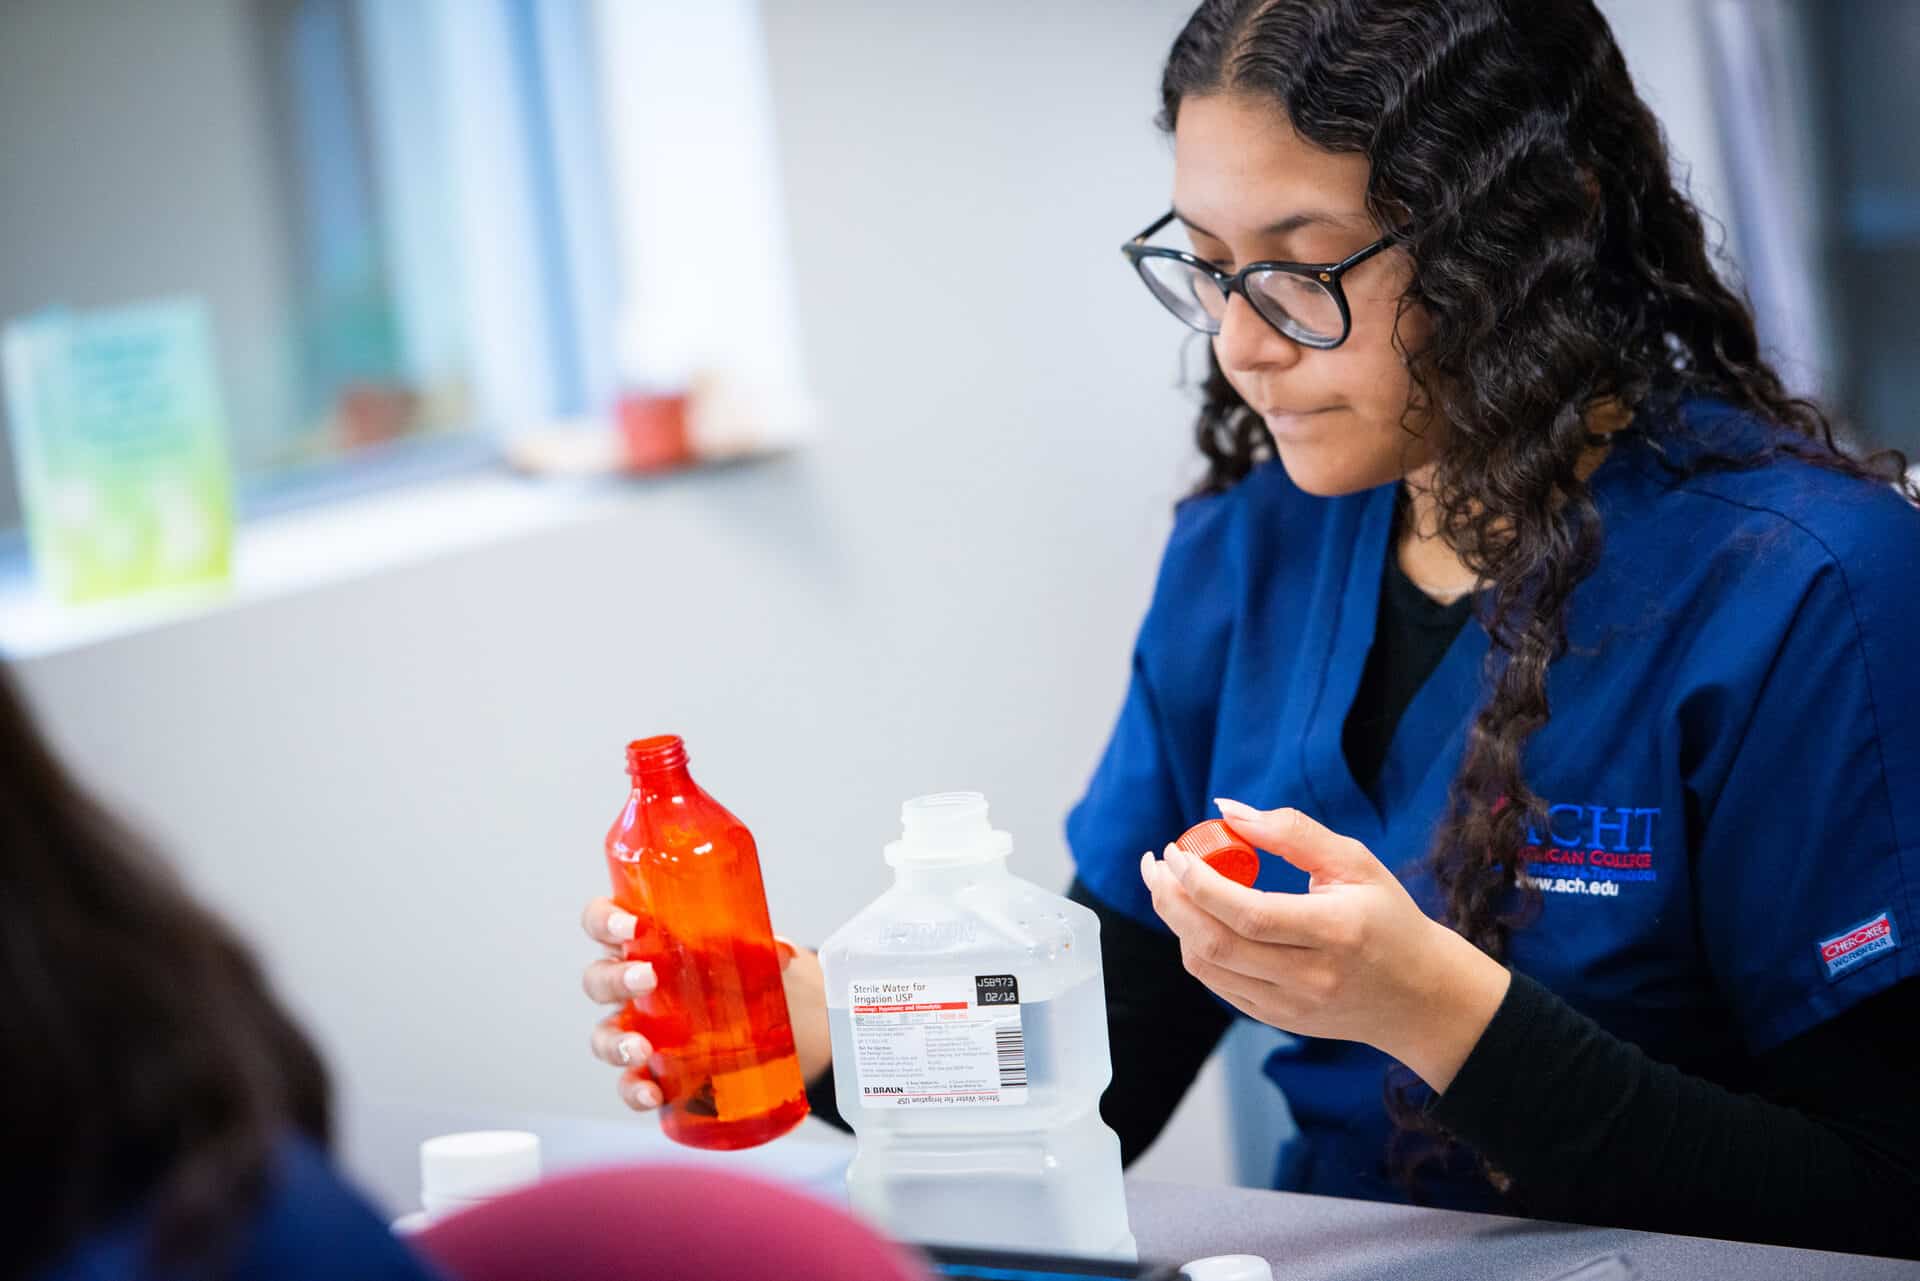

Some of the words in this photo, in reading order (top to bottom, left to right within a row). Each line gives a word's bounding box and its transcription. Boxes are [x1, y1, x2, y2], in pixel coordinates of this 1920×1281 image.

[1825, 922, 1884, 957] CHEROKEE
[1833, 938, 1887, 968] WORKWEAR
[854, 984, 880, 994] Sterile
[882, 983, 909, 993] Water
[913, 982, 926, 991] for
[854, 994, 892, 1006] Irrigation
[895, 993, 913, 1003] USP
[985, 991, 1016, 1002] 02/18
[872, 1086, 904, 1094] BRAUN
[896, 1097, 911, 1105] USP
[912, 1096, 942, 1105] Irrigation
[943, 1096, 954, 1104] for
